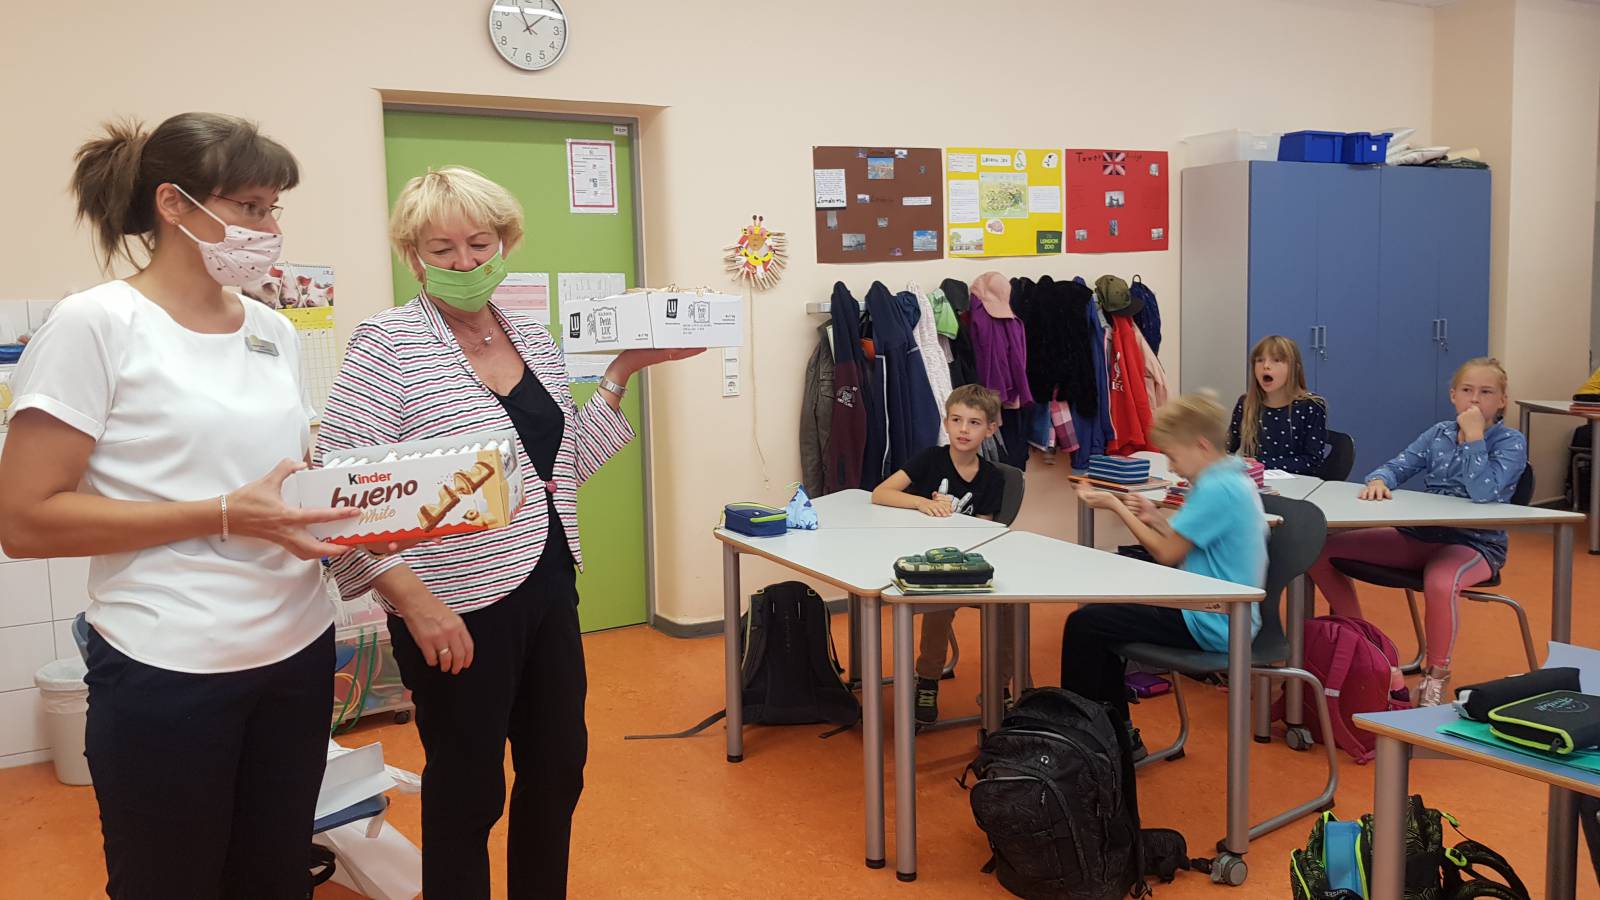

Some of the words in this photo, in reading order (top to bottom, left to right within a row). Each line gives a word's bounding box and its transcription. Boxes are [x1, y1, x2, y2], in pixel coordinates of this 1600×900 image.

[496, 20, 502, 30] 9
[553, 26, 560, 36] 3
[501, 36, 508, 46] 8
[549, 41, 555, 49] 4
[512, 47, 518, 57] 7
[539, 50, 545, 60] 5
[525, 53, 532, 63] 6
[348, 472, 392, 485] Kinder
[331, 479, 418, 509] bueno
